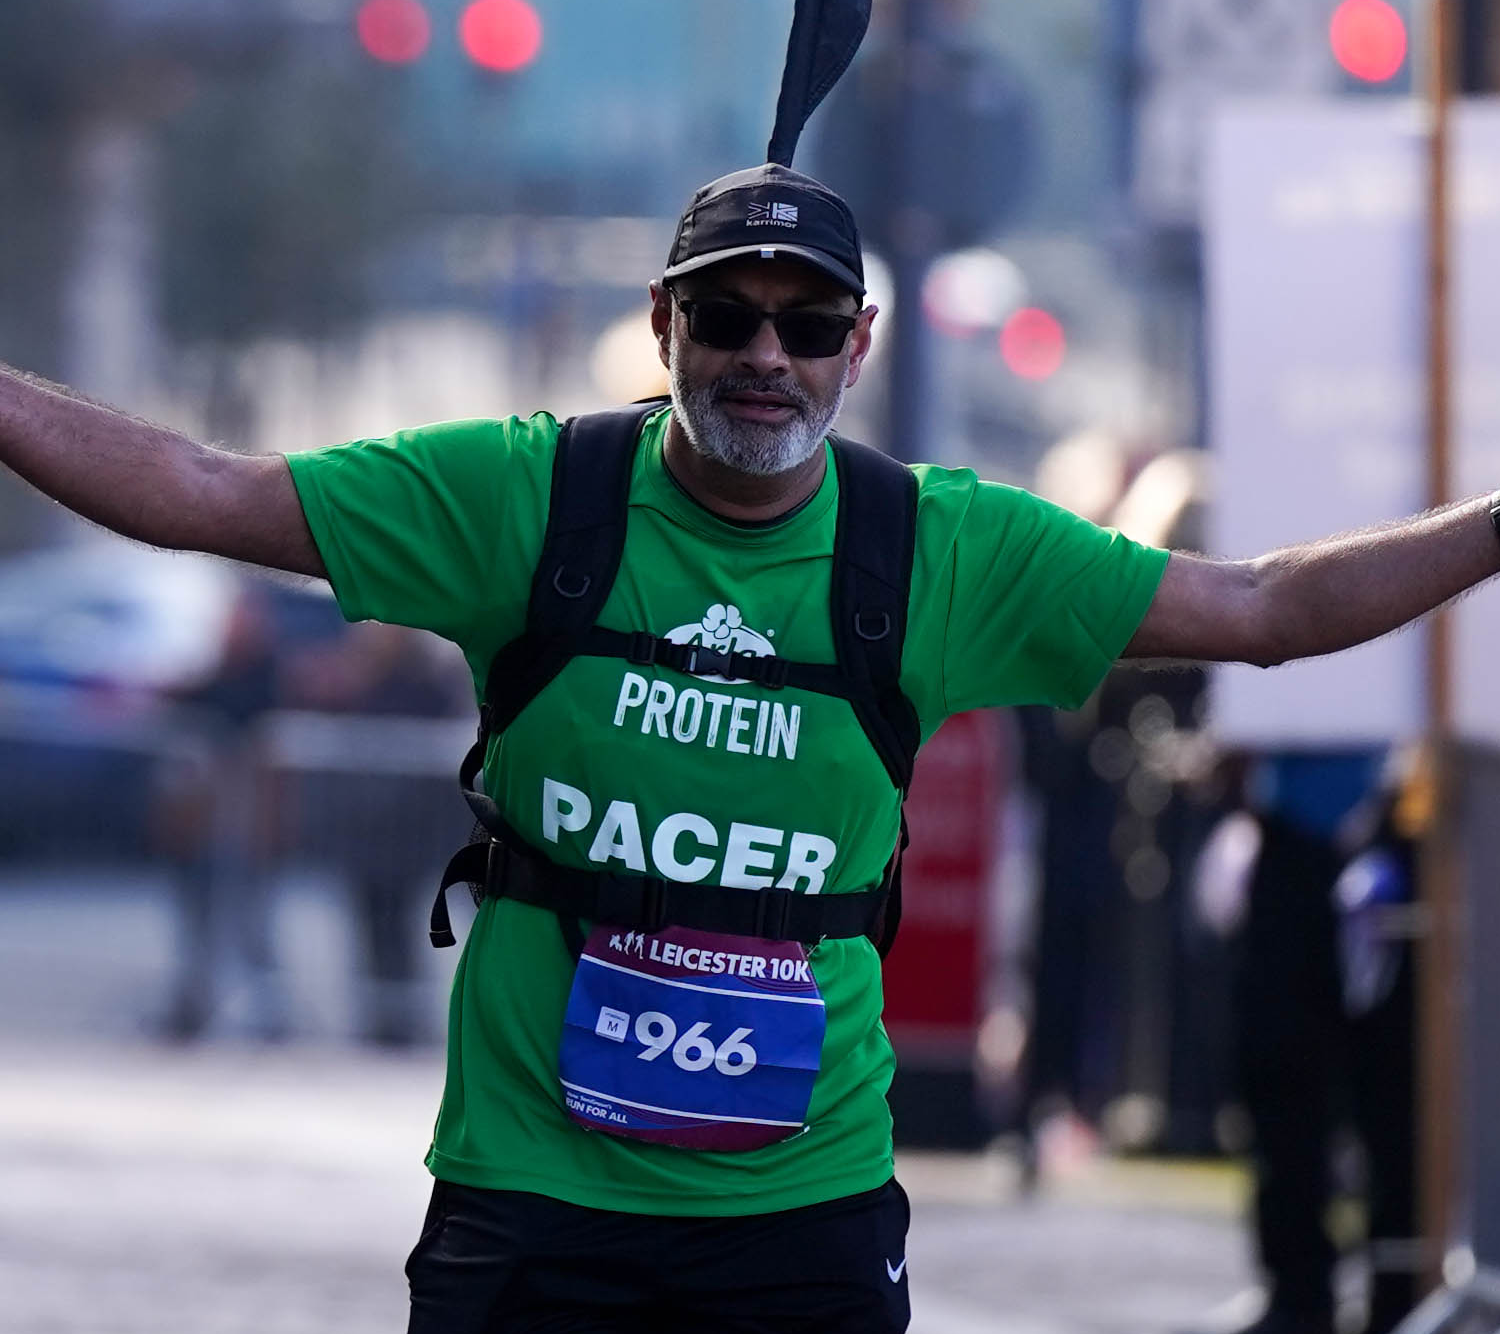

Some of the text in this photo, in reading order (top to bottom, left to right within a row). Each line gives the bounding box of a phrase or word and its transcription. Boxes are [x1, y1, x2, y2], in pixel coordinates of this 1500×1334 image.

[745, 218, 798, 230] karrimor
[613, 671, 801, 761] PROTEIN
[542, 777, 837, 896] PACER
[649, 938, 810, 983] LEICESTER 10K
[607, 1020, 619, 1033] M
[634, 1010, 757, 1077] 966
[565, 1096, 586, 1113] RUN
[585, 1104, 608, 1119] FOR
[608, 1111, 628, 1124] ALL
